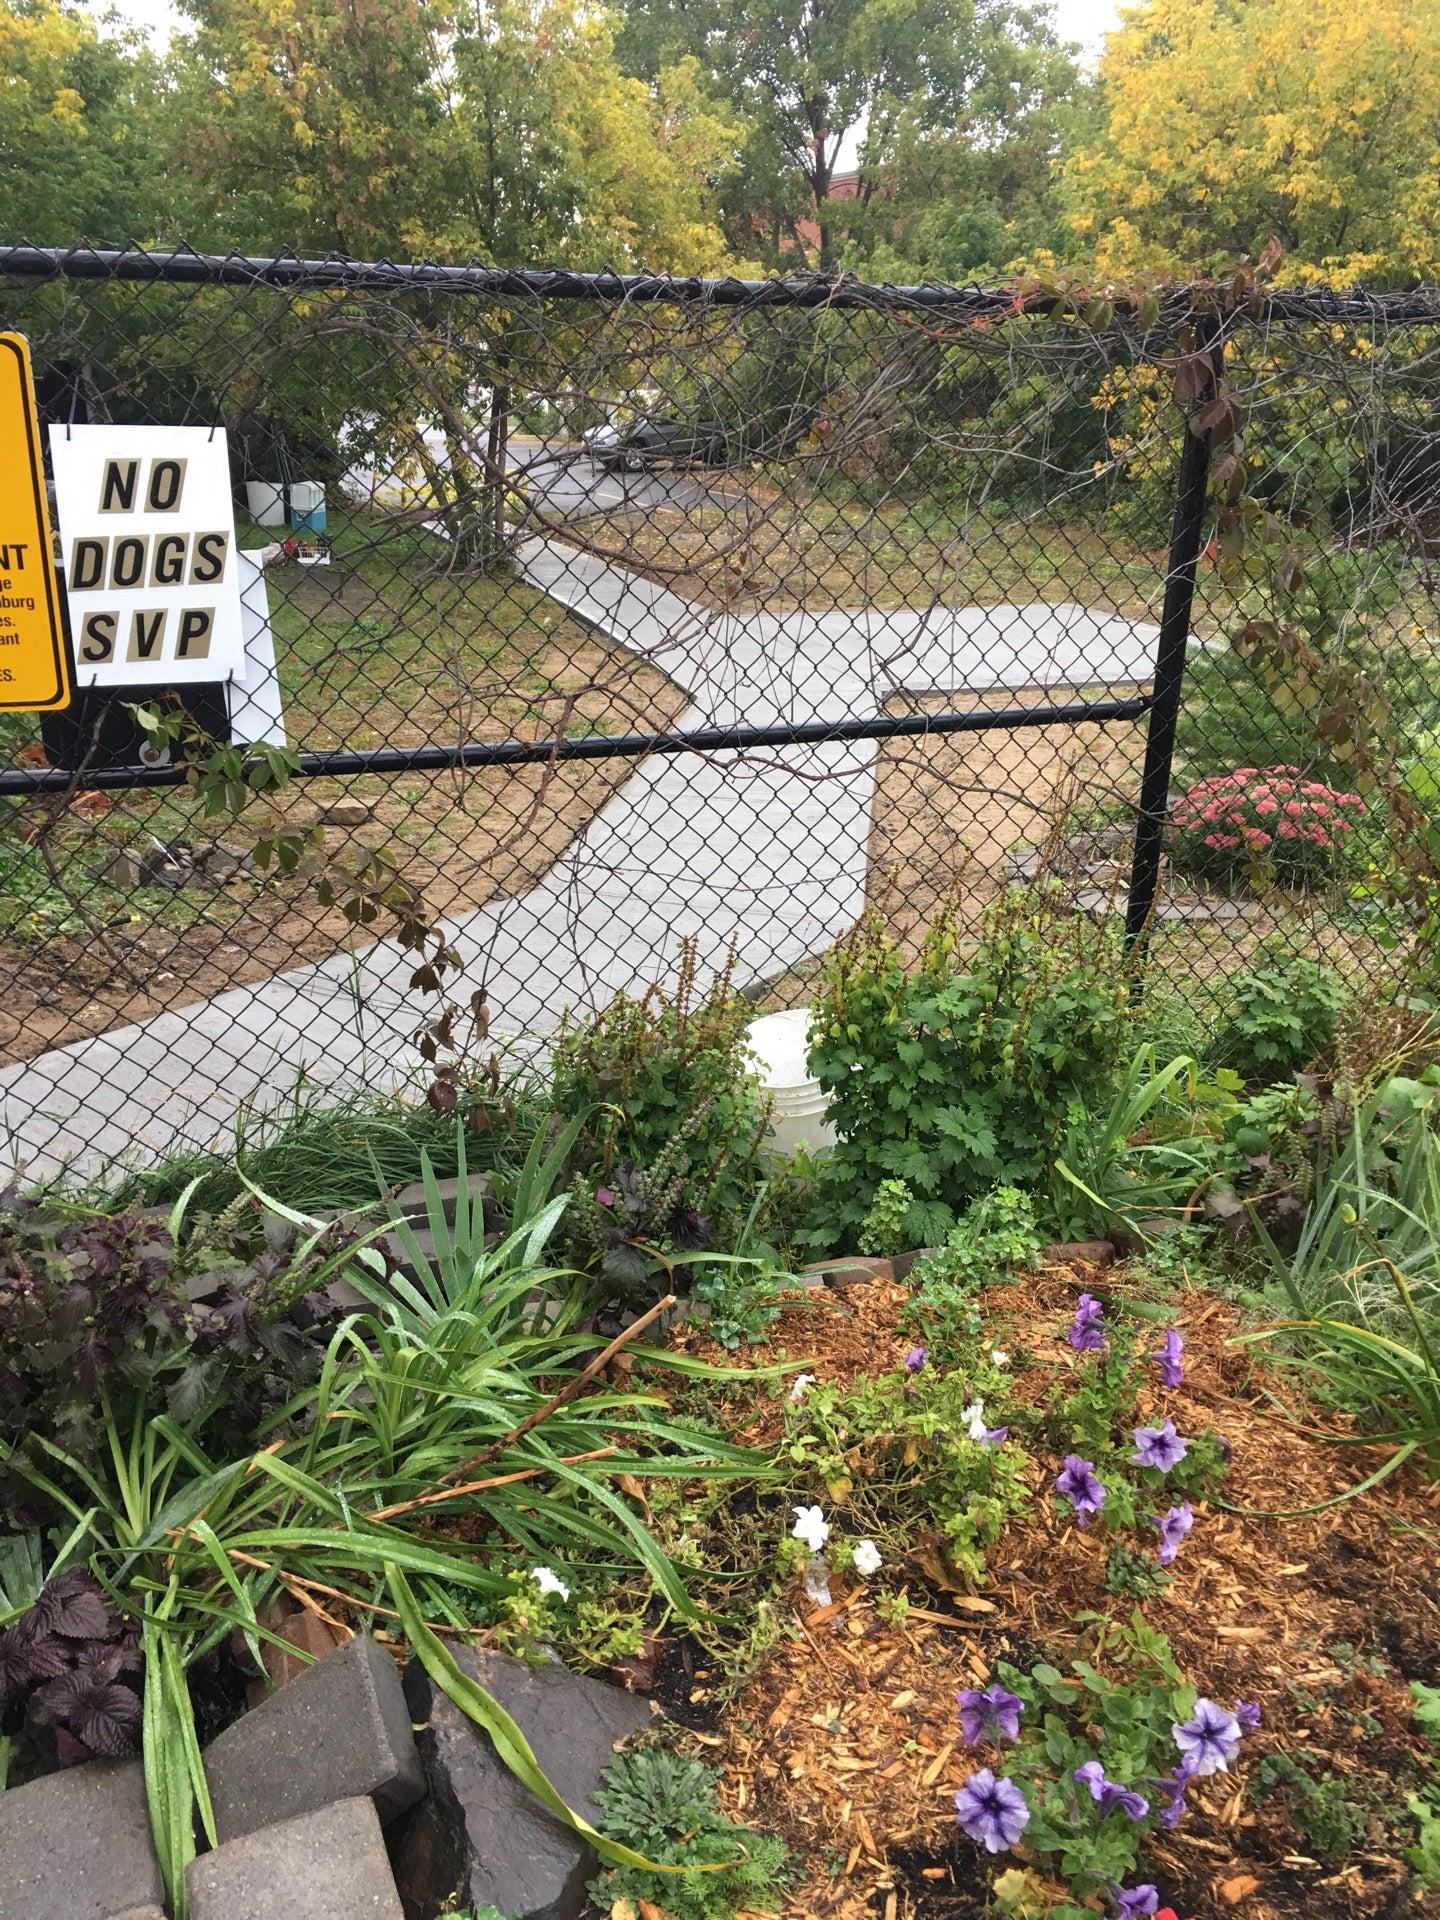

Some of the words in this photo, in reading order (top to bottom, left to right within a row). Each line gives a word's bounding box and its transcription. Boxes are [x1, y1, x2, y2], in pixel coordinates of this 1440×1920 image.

[102, 460, 182, 510] NO
[0, 579, 12, 592] e
[73, 534, 226, 588] DOGS
[0, 595, 35, 611] burg
[83, 610, 211, 662] SVP
